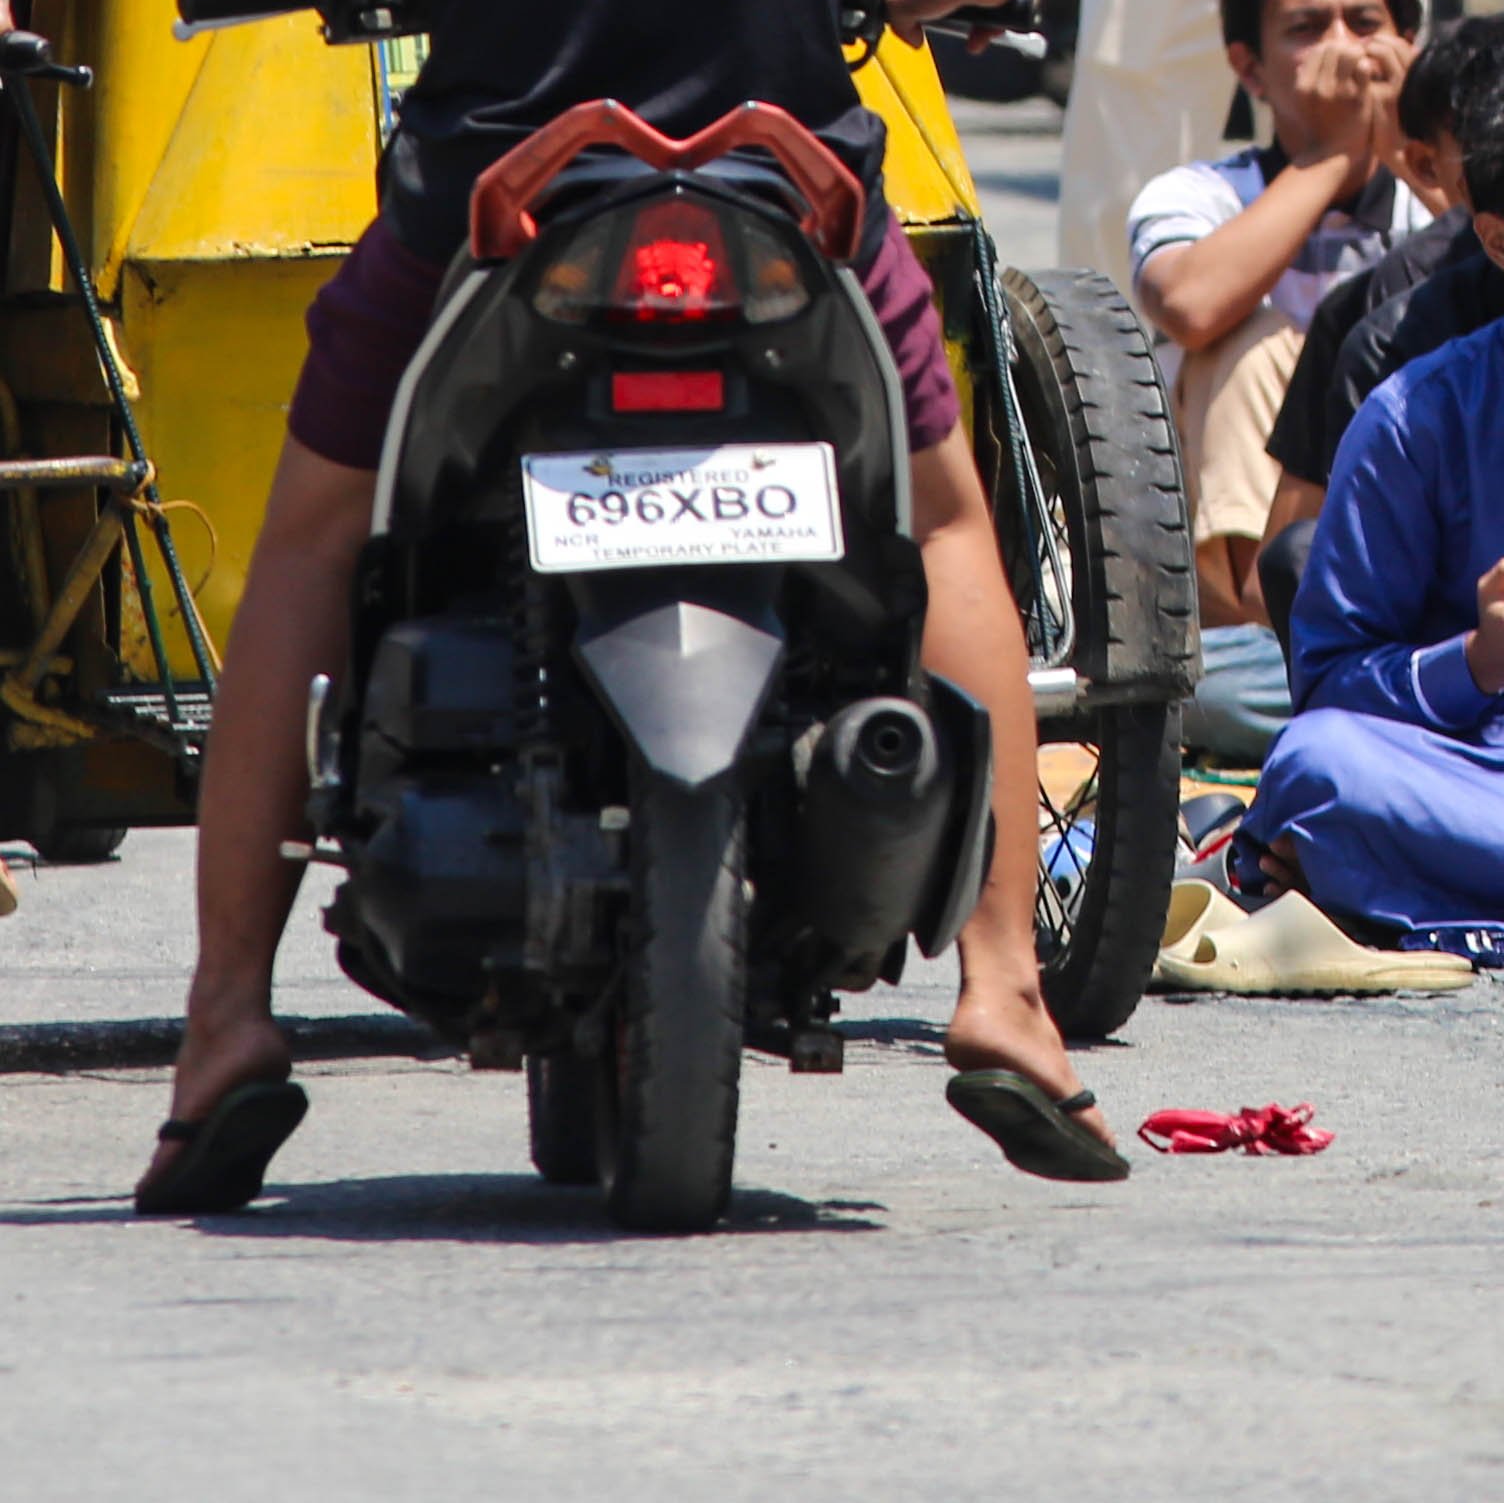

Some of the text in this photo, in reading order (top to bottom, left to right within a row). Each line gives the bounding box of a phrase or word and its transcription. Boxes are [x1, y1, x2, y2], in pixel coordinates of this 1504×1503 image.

[608, 469, 749, 487] REGISTERED
[554, 526, 817, 547] NCR YAMAHA
[592, 541, 784, 560] TEMPORARY PLATE
